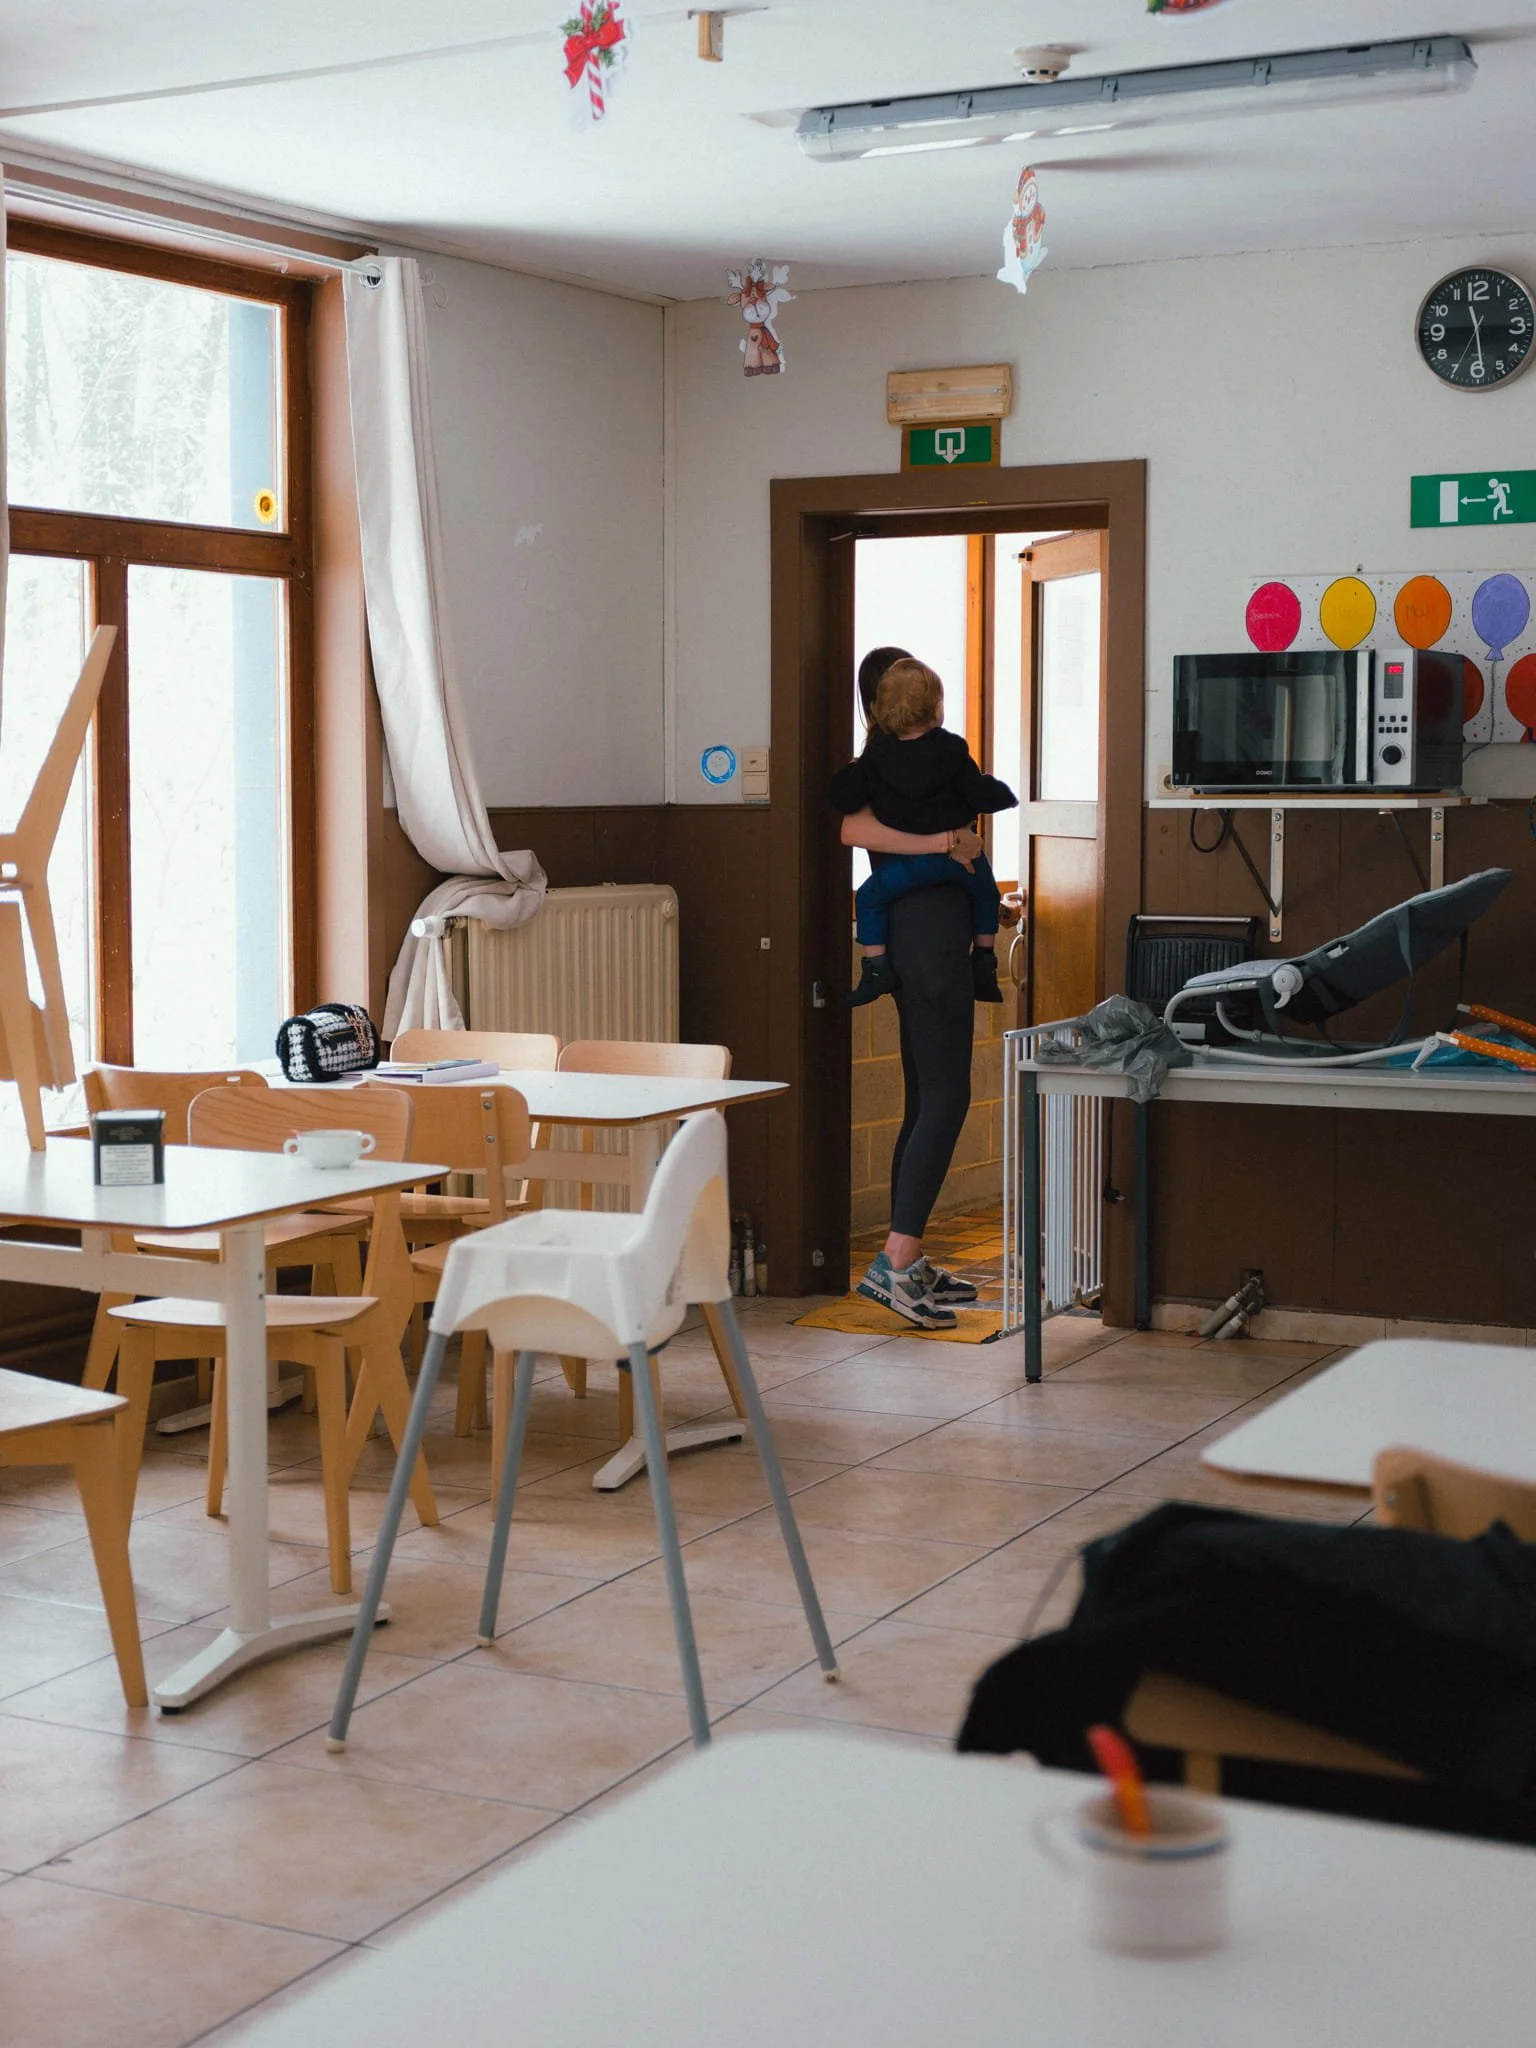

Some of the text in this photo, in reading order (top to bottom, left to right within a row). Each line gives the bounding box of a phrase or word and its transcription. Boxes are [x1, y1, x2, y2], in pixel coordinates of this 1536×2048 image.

[1454, 288, 1461, 301] 11
[1468, 280, 1490, 302] 12
[1497, 285, 1501, 297] 1
[1509, 299, 1519, 310] 2
[1436, 305, 1449, 317] 10
[1430, 323, 1446, 341] 9
[1509, 317, 1526, 335] 3
[1508, 343, 1519, 353] 4
[1437, 349, 1448, 360] 8
[1451, 364, 1459, 374] 7
[1470, 361, 1485, 378] 6
[1495, 360, 1505, 370] 5
